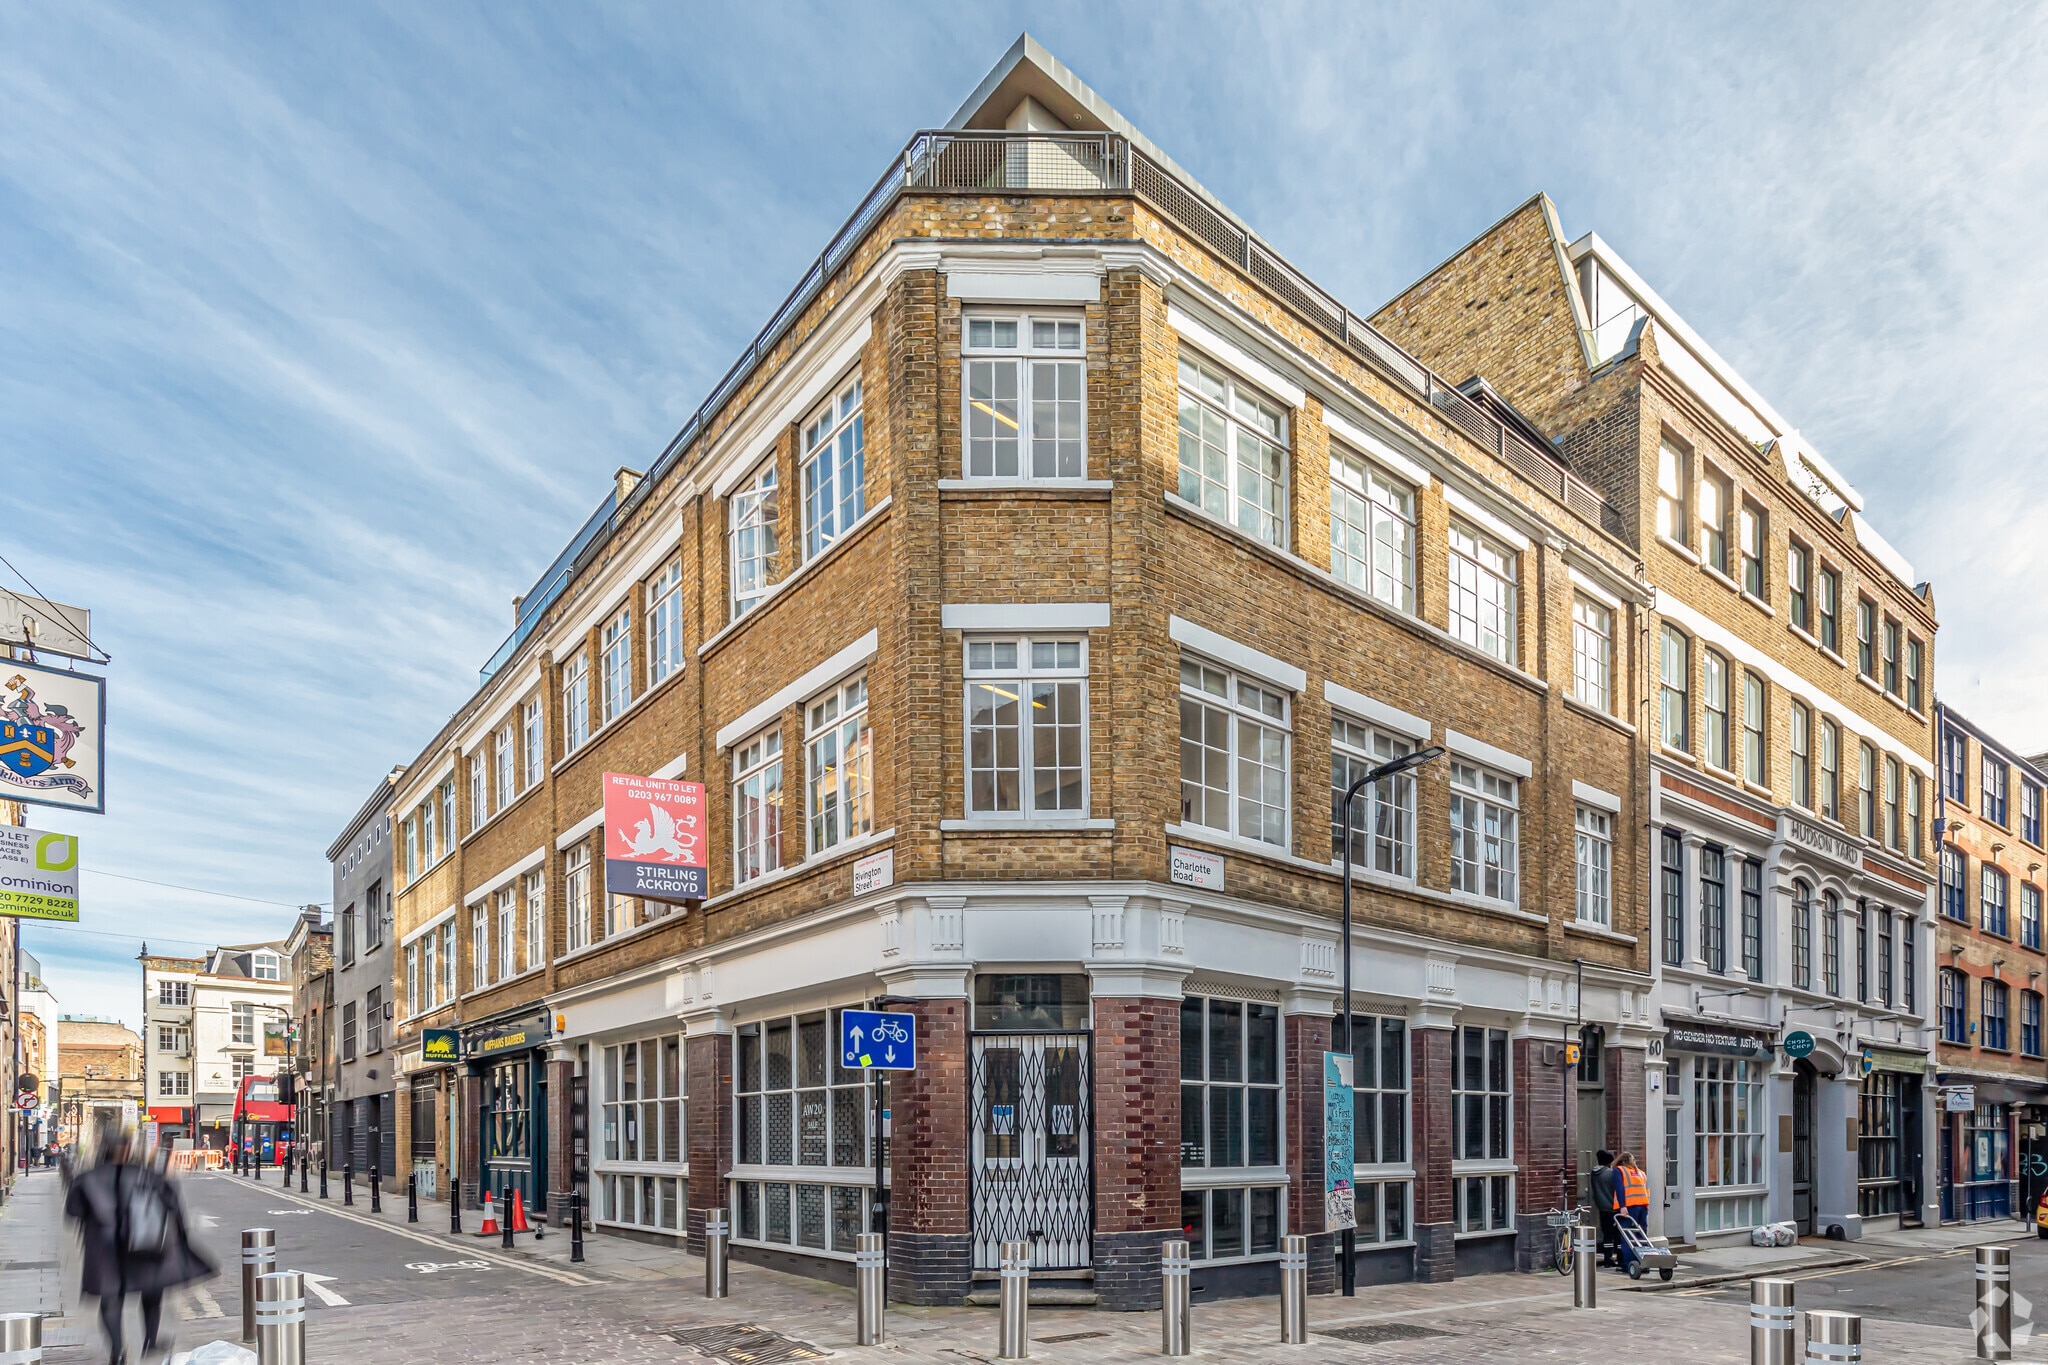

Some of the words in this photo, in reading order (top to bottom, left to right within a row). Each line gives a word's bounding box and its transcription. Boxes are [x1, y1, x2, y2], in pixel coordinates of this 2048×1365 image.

[48, 777, 84, 788] Arms
[612, 776, 644, 787] RETAIL
[646, 780, 666, 790] UNIT
[668, 783, 680, 791] TO
[681, 785, 697, 794] LET
[628, 790, 652, 800] 0203
[654, 792, 672, 802] 967
[674, 795, 697, 804] 0089
[8, 832, 29, 841] LET
[1791, 820, 1832, 853] HUDSON
[1835, 840, 1858, 864] YARD
[1174, 858, 1211, 874] Charlotte
[636, 866, 698, 881] STIRLING
[855, 868, 881, 882] Rivington
[1174, 869, 1193, 881] Road
[636, 879, 698, 893] ACKROYD
[856, 880, 872, 892] Street
[15, 895, 43, 904] 7729
[47, 899, 74, 909] 8228
[485, 1036, 504, 1051] RUFFIANS
[505, 1032, 525, 1046] BARBERS
[1673, 1030, 1683, 1040] NO
[1684, 1031, 1705, 1044] GENDER
[1706, 1034, 1714, 1044] NO
[1715, 1035, 1737, 1046] TEXTURE
[1740, 1038, 1751, 1048] JUST
[1752, 1039, 1763, 1050] HAIR
[1649, 1039, 1661, 1056] 60
[1782, 1053, 1790, 1068] 59
[803, 1104, 822, 1116] AW20
